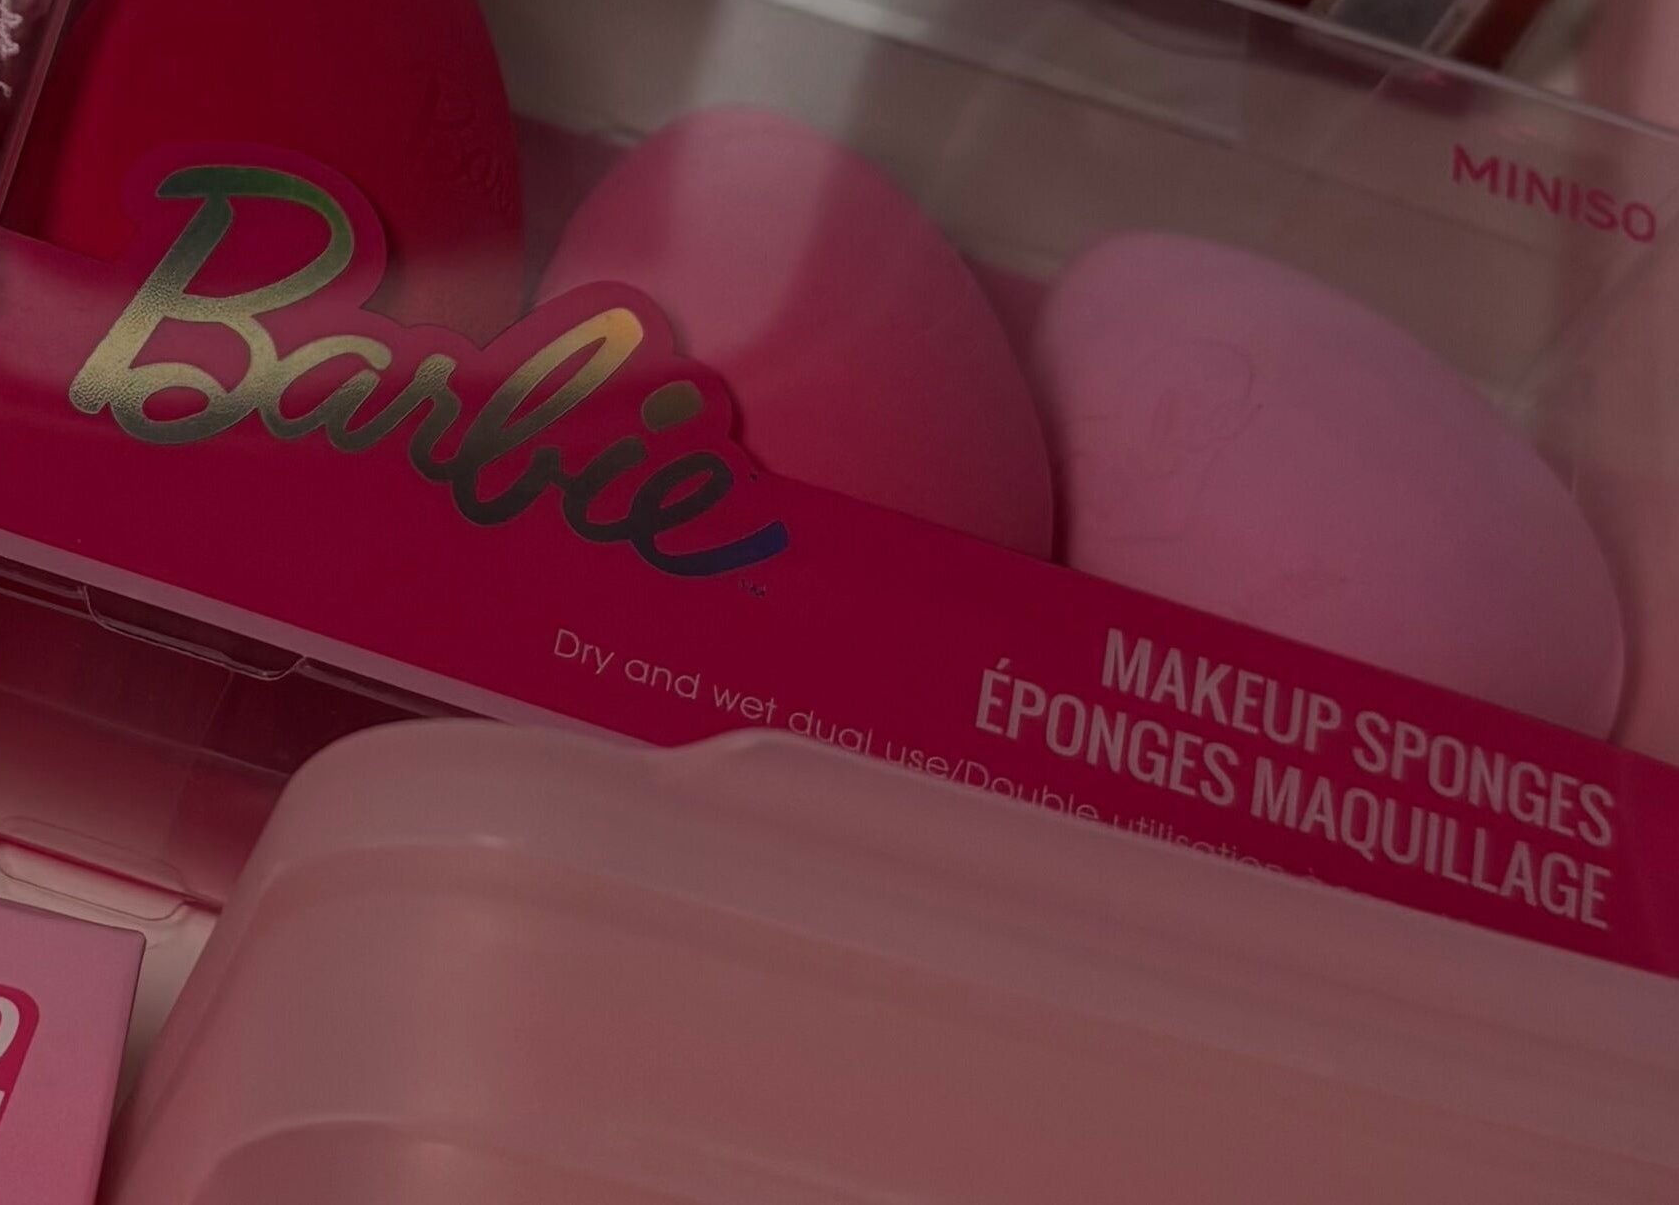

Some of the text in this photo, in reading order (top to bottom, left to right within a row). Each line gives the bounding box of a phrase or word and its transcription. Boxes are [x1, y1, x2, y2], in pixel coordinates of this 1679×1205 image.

[1452, 143, 1656, 243] MINISO
[69, 163, 791, 579] Barbie
[553, 627, 616, 676] Dry
[624, 657, 701, 700] and
[713, 683, 778, 725] wet
[788, 708, 873, 756] dual
[975, 656, 1612, 932] ÉPONGES MAQUILLAGE
[1102, 627, 1617, 849] MAKEUP SPONGES
